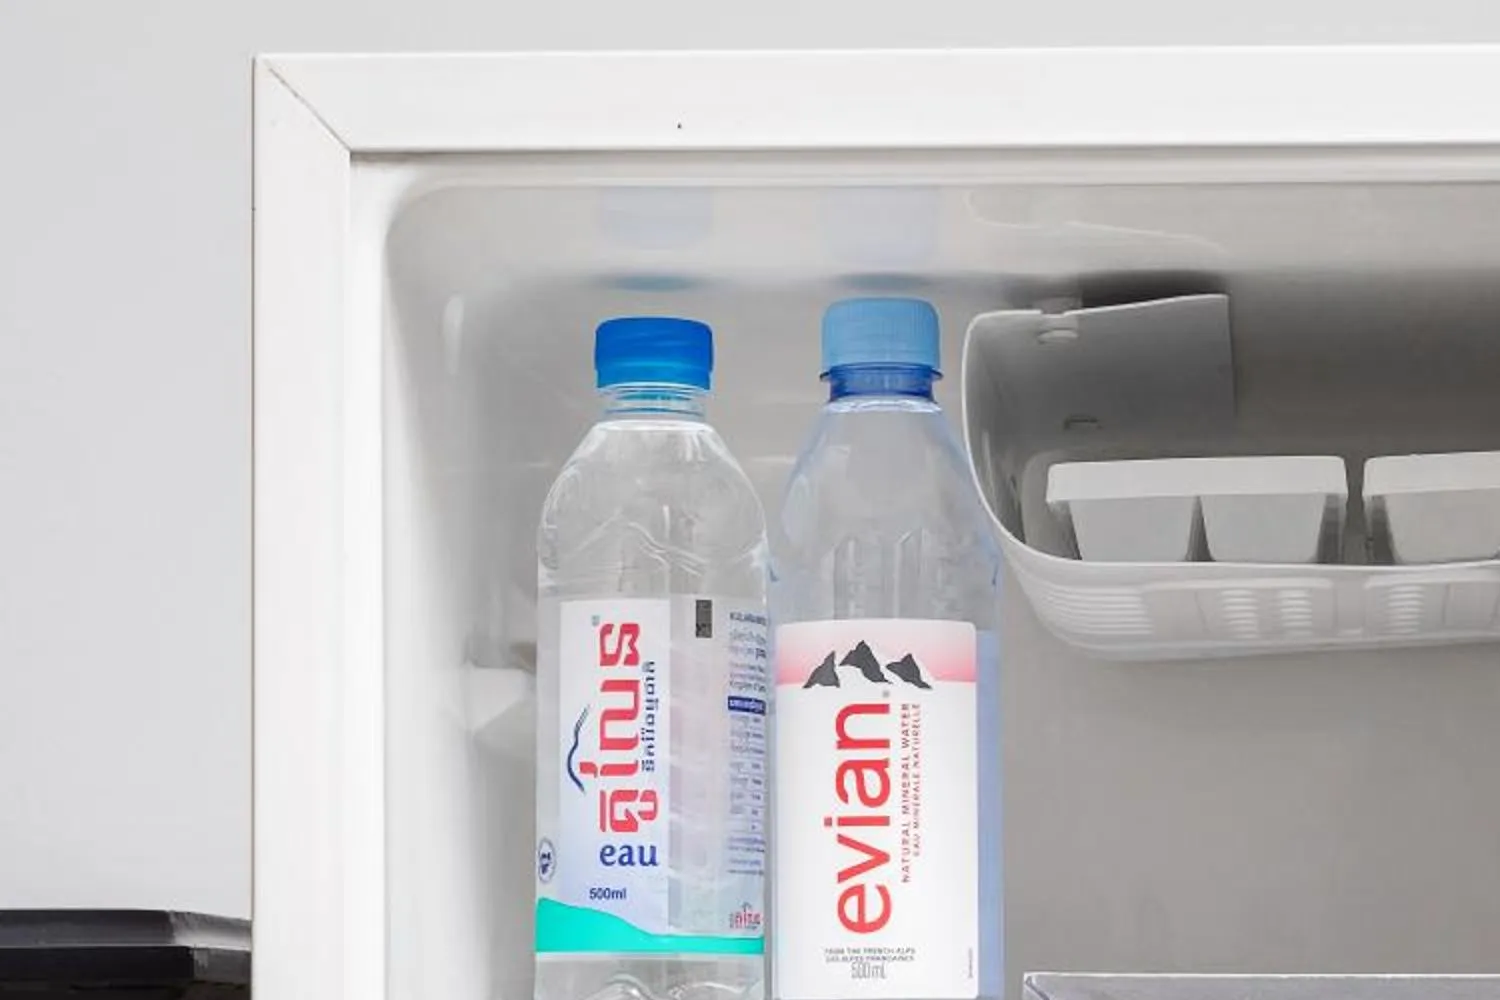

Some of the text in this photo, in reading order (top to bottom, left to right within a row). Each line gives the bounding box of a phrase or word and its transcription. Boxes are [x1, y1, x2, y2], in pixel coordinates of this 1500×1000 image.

[824, 703, 891, 934] evian
[901, 703, 911, 883] NATURAL MINERAL WATER
[588, 887, 627, 900] 500ml
[599, 844, 659, 867] eau
